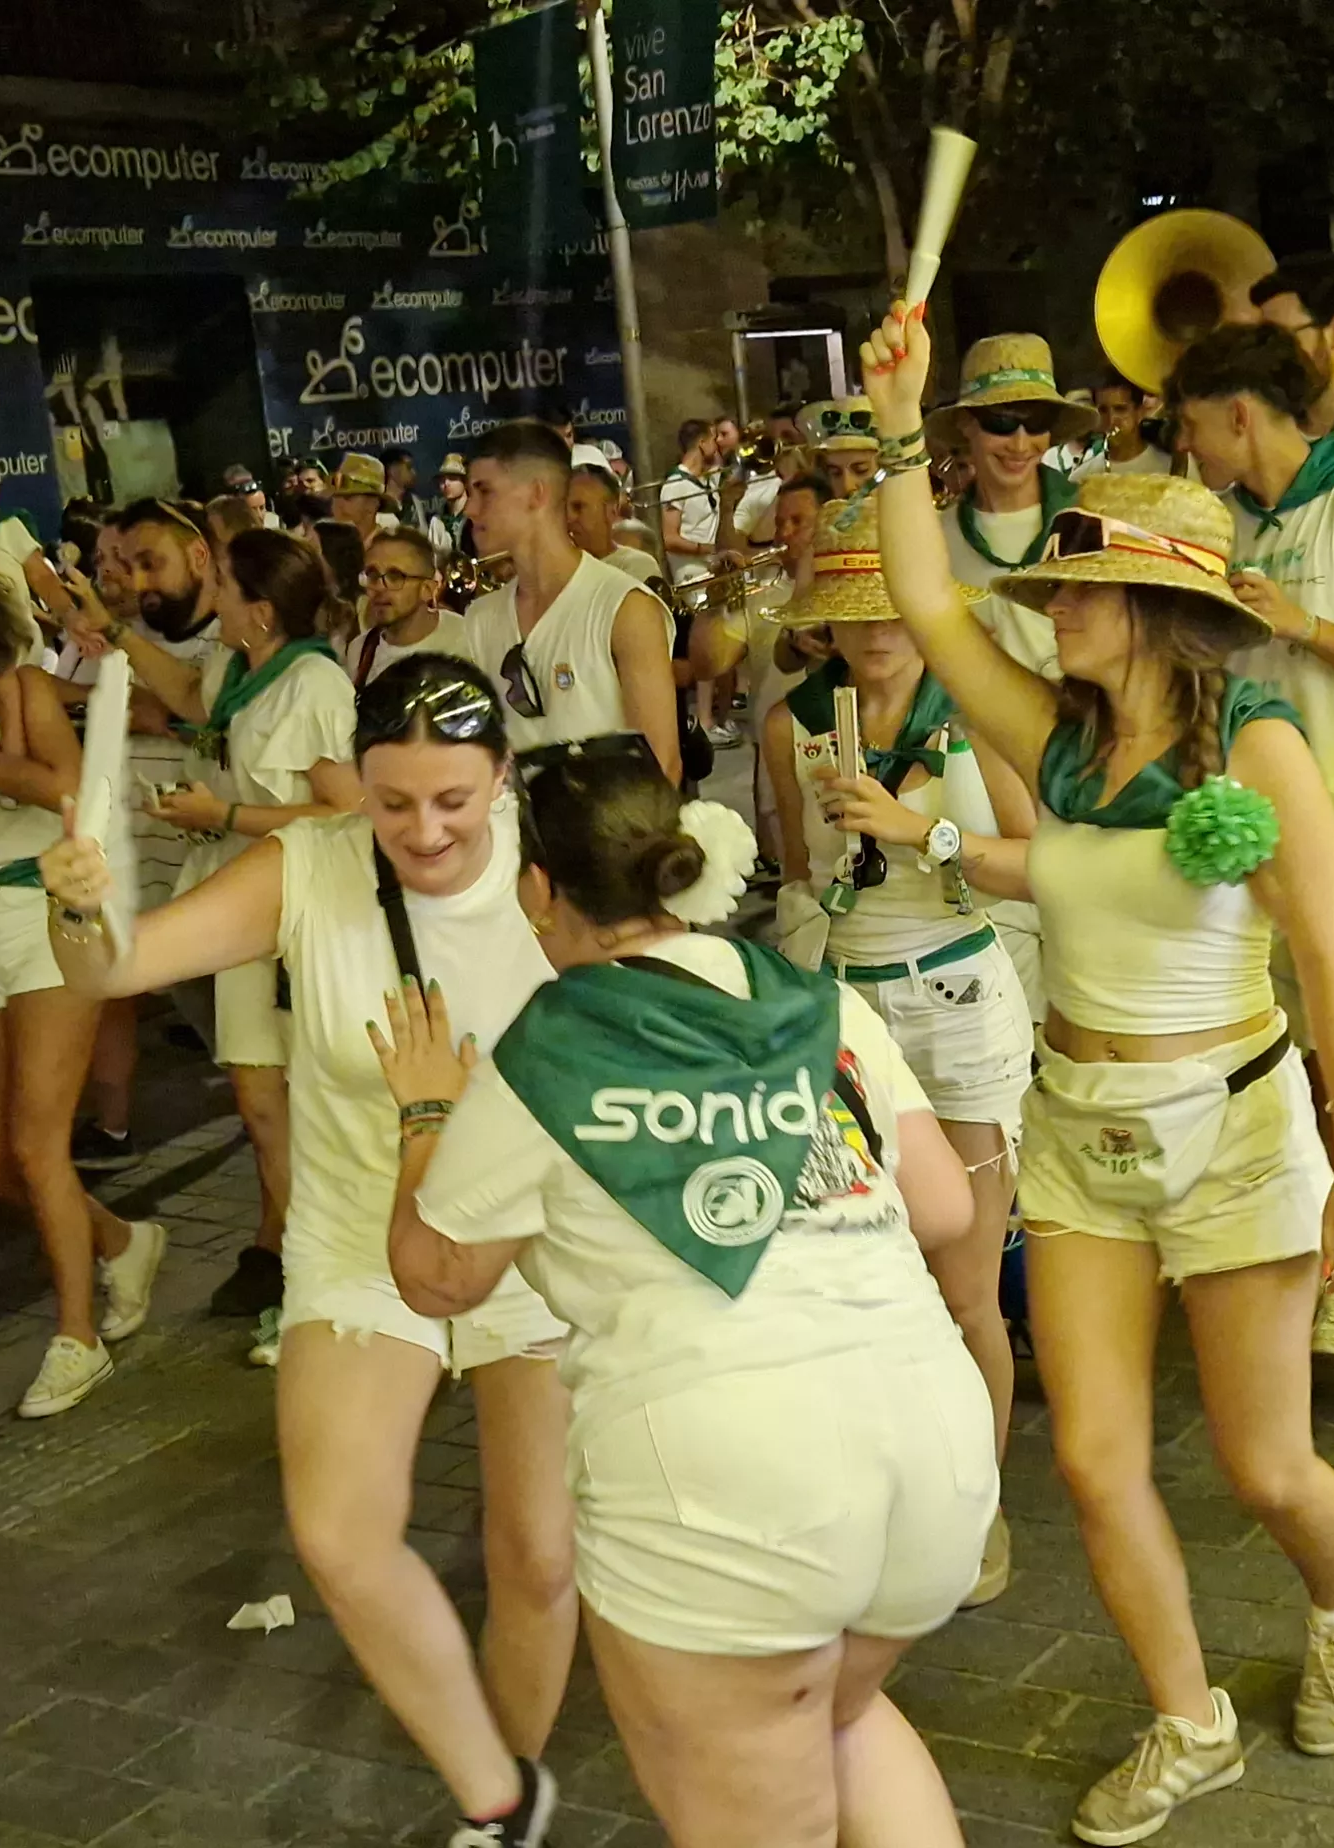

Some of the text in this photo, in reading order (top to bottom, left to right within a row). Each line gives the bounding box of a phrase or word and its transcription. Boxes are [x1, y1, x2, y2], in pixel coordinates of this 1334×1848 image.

[624, 22, 665, 61] vive
[624, 65, 665, 103] San
[625, 102, 712, 146] Lorenzo
